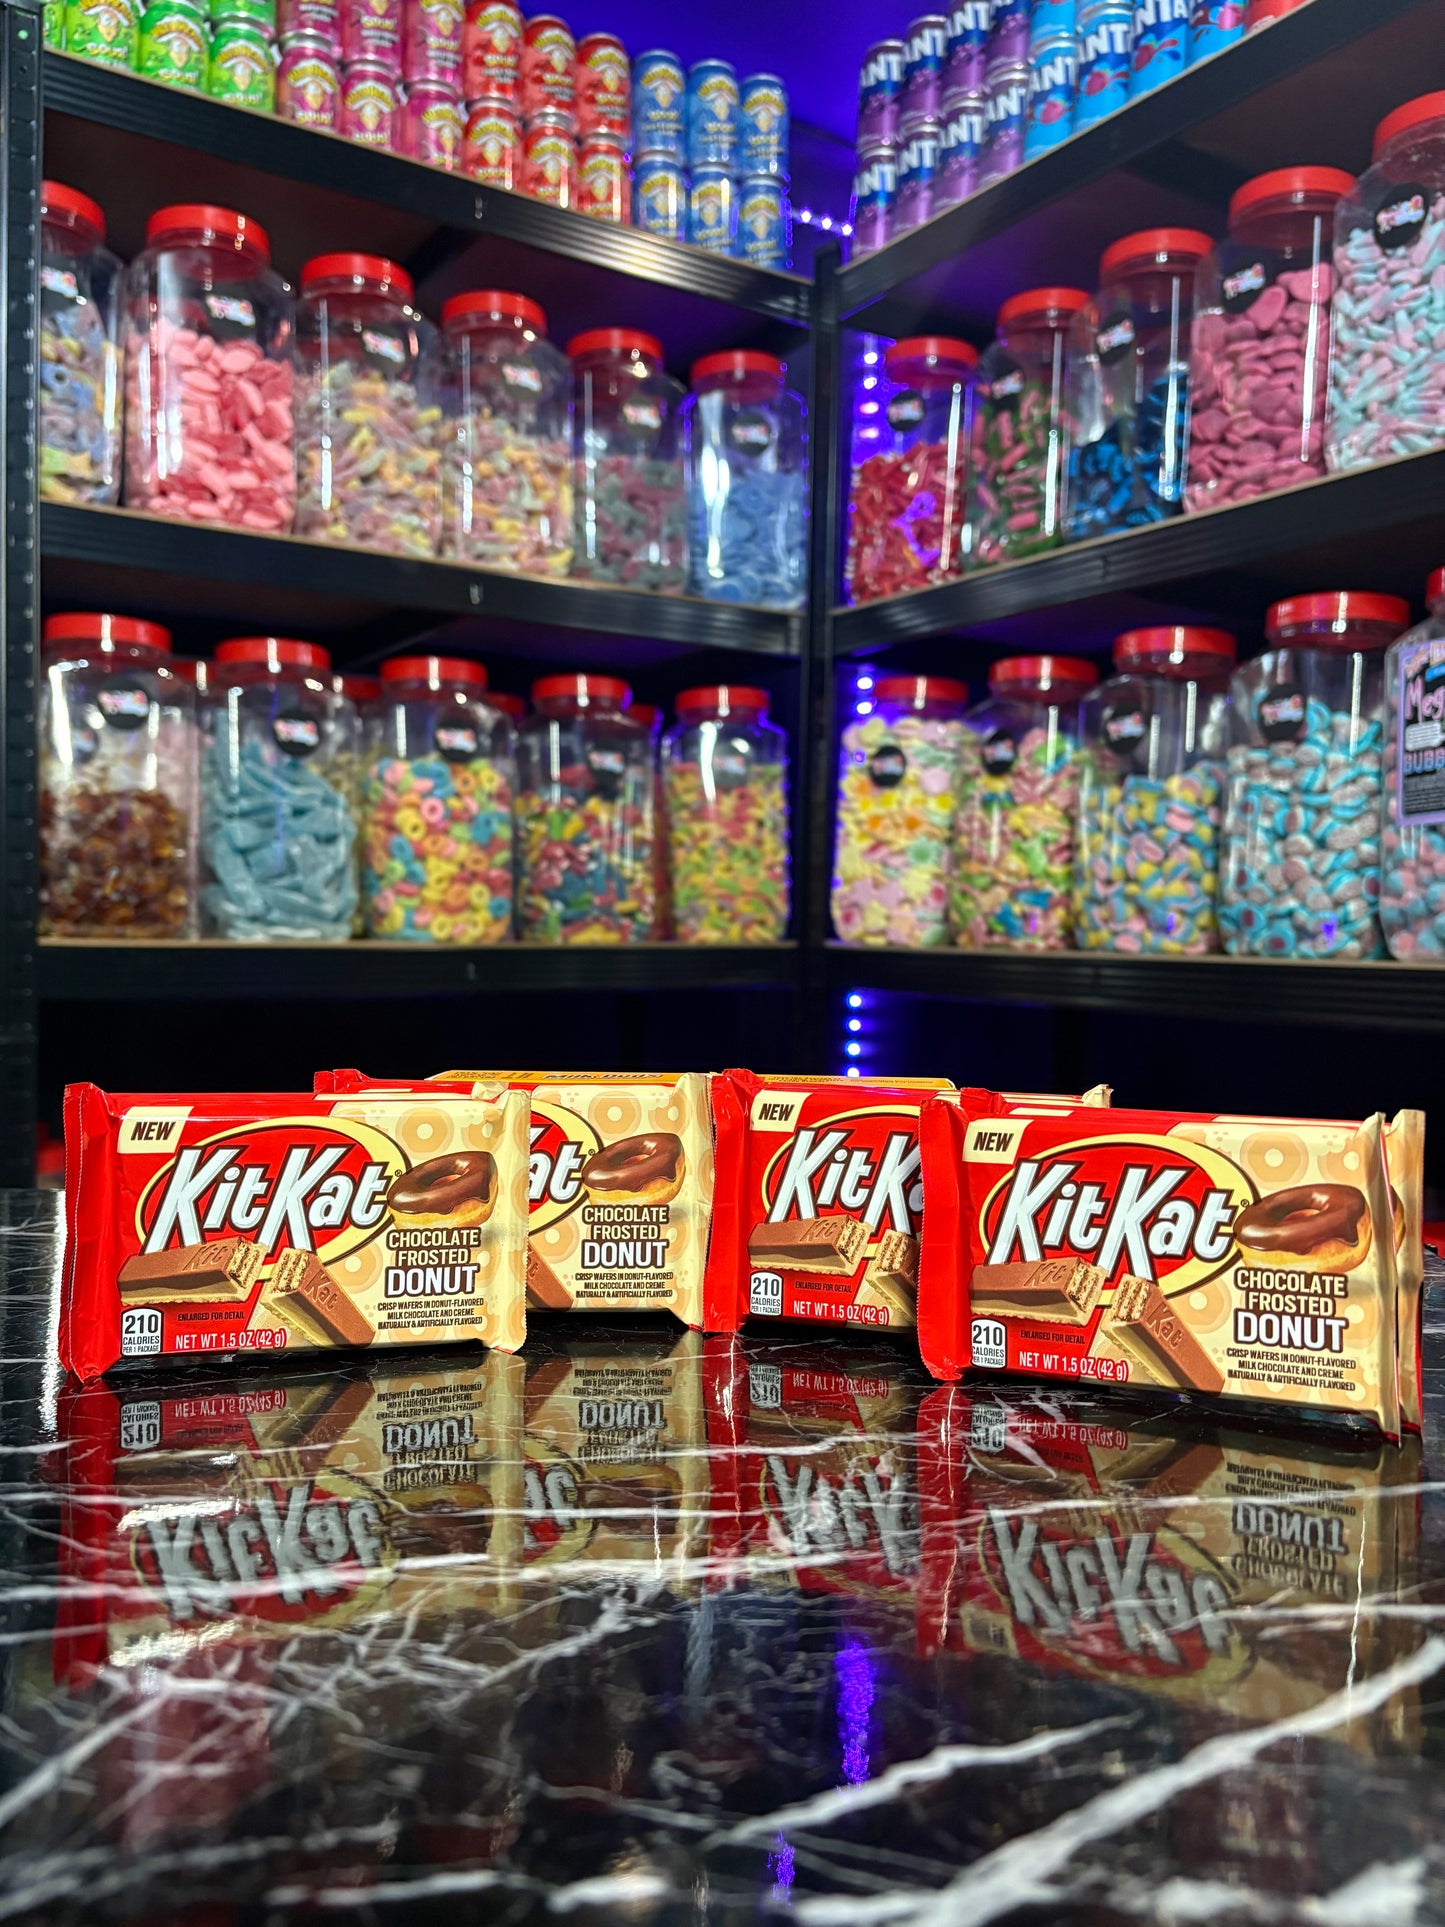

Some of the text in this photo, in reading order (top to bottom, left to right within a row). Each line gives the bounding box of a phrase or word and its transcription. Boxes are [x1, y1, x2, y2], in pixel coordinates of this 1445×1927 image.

[758, 1103, 795, 1122] NEW
[130, 1120, 177, 1141] NEW
[973, 1131, 1014, 1153] NEW
[584, 1207, 668, 1223] CHOCOLATE
[388, 1229, 479, 1249] CHOCOLATE
[593, 1225, 658, 1240] FROSTED
[398, 1248, 469, 1267] FROSTED
[583, 1242, 667, 1267] DONUT
[387, 1266, 478, 1297] DONUT
[575, 1273, 593, 1281] CRISP
[594, 1273, 617, 1281] WAFERS
[618, 1273, 624, 1281] IN
[584, 1281, 665, 1290] MILK CHOCOLATE AND CREME
[1237, 1269, 1345, 1297] CHOCOLATE
[646, 1289, 673, 1298] FLAVORED
[753, 1277, 780, 1297] 210
[795, 1281, 852, 1293] ENLARGED FOR DETAIL
[378, 1298, 484, 1311] CRISP WAFERS IN DONUT-FLAVORED
[751, 1297, 781, 1307] CALORIES
[762, 1306, 780, 1314] PACKAGE
[1248, 1292, 1333, 1316] FROSTED
[177, 1311, 245, 1322] ENLARGED FOR DETAIL
[387, 1308, 475, 1320] MILK CHOCOLATE AND CREME
[793, 1300, 889, 1326] NET WT 1.5 OZ (42 g)
[124, 1314, 159, 1335] 210
[378, 1317, 483, 1330] NATURALLY & ARTIFICIALLY FLAVORED
[1237, 1311, 1346, 1351] DONUT
[122, 1335, 160, 1346] CALORIES
[175, 1329, 286, 1350] NET WT 1.5 OZ (42 g)
[972, 1324, 1003, 1346] 210
[1020, 1330, 1086, 1345] ENLARGED FOR DETAIL
[137, 1345, 160, 1353] PACKAGE
[1226, 1348, 1356, 1369] CRISP WAFERS IN DONUT-FLAVORED
[984, 1357, 1004, 1366] PACKAGE
[1019, 1351, 1127, 1381] NET WT 1.5 OZ (42 g)
[1238, 1360, 1344, 1379] MILK CHOCOLATE AND CREME
[1228, 1369, 1266, 1383] NATURALLY
[1273, 1374, 1318, 1388] ARTIFICIALLY
[1319, 1379, 1356, 1391] FLAVORED
